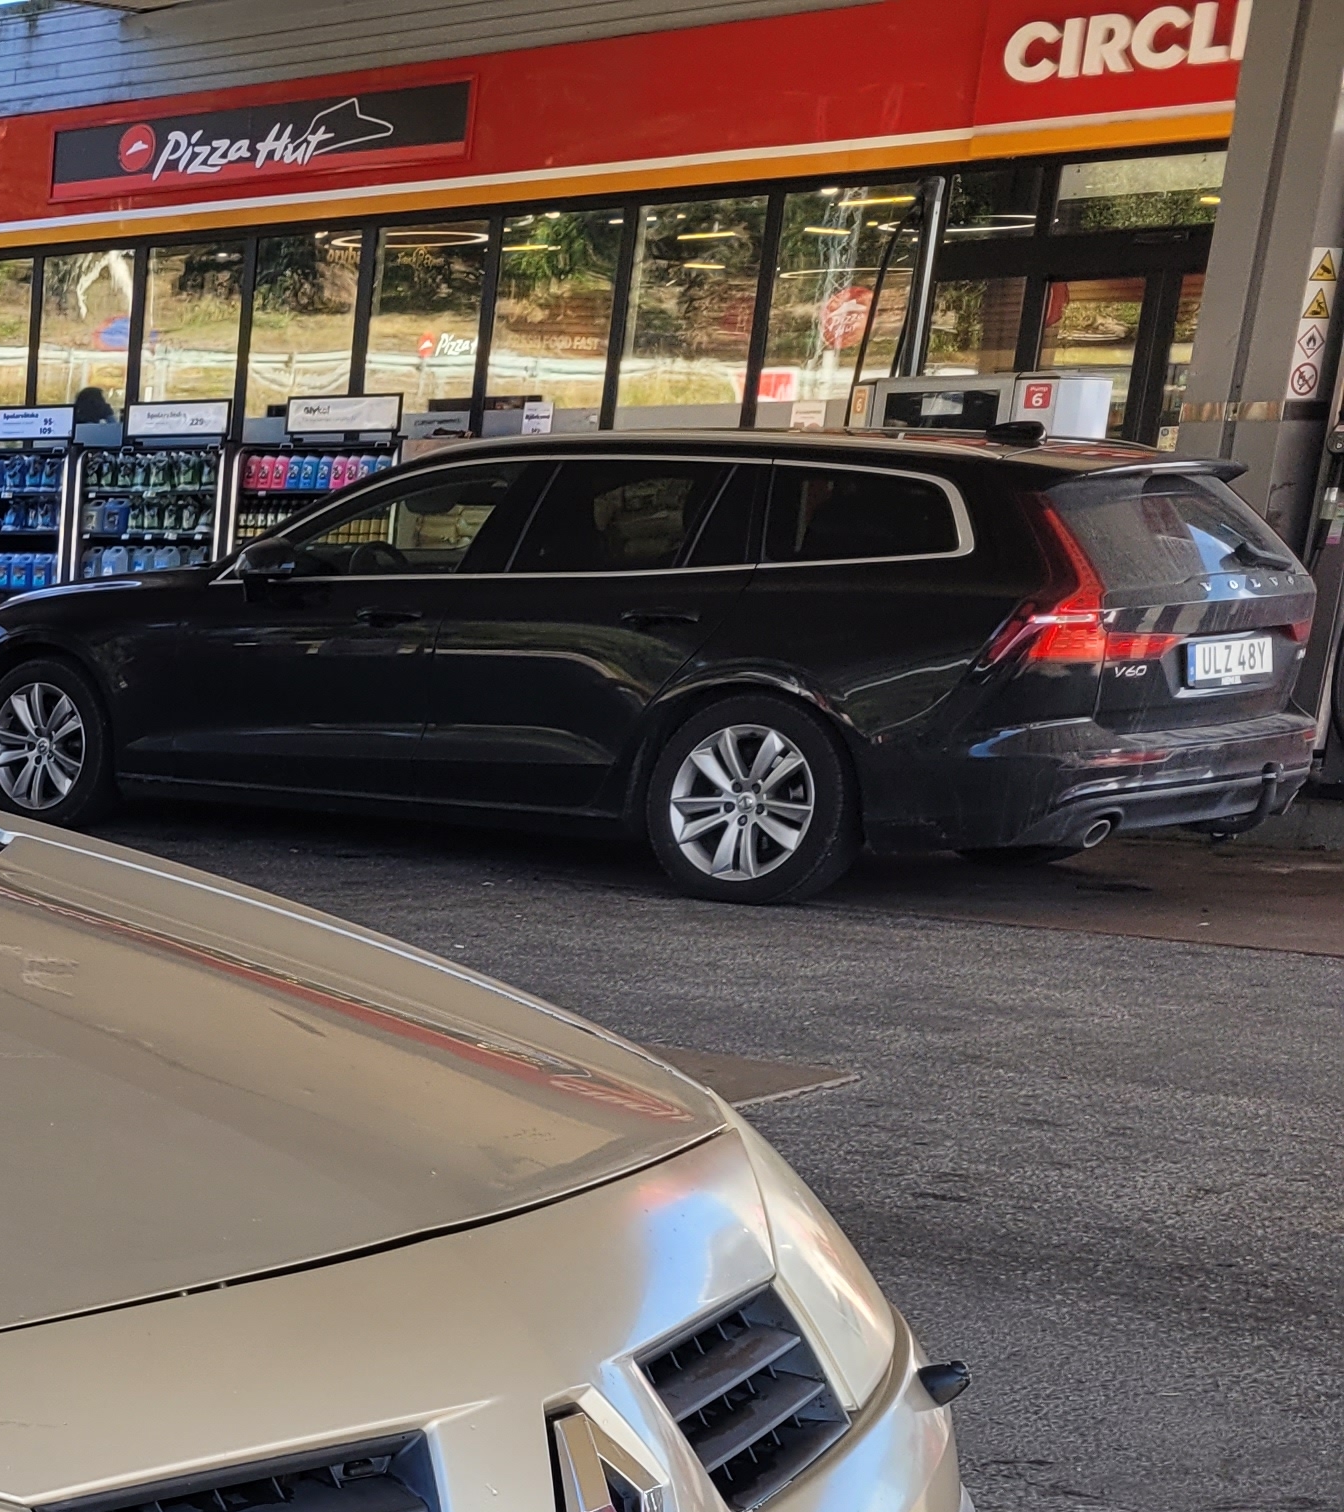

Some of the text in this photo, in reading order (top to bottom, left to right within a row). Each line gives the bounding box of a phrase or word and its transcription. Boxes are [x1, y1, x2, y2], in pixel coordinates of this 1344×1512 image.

[152, 123, 335, 181] Pizza Hut
[435, 333, 470, 357] Pizza
[1032, 392, 1043, 406] 6
[1202, 641, 1266, 675] ULZ 48Y
[1115, 665, 1147, 678] V60
